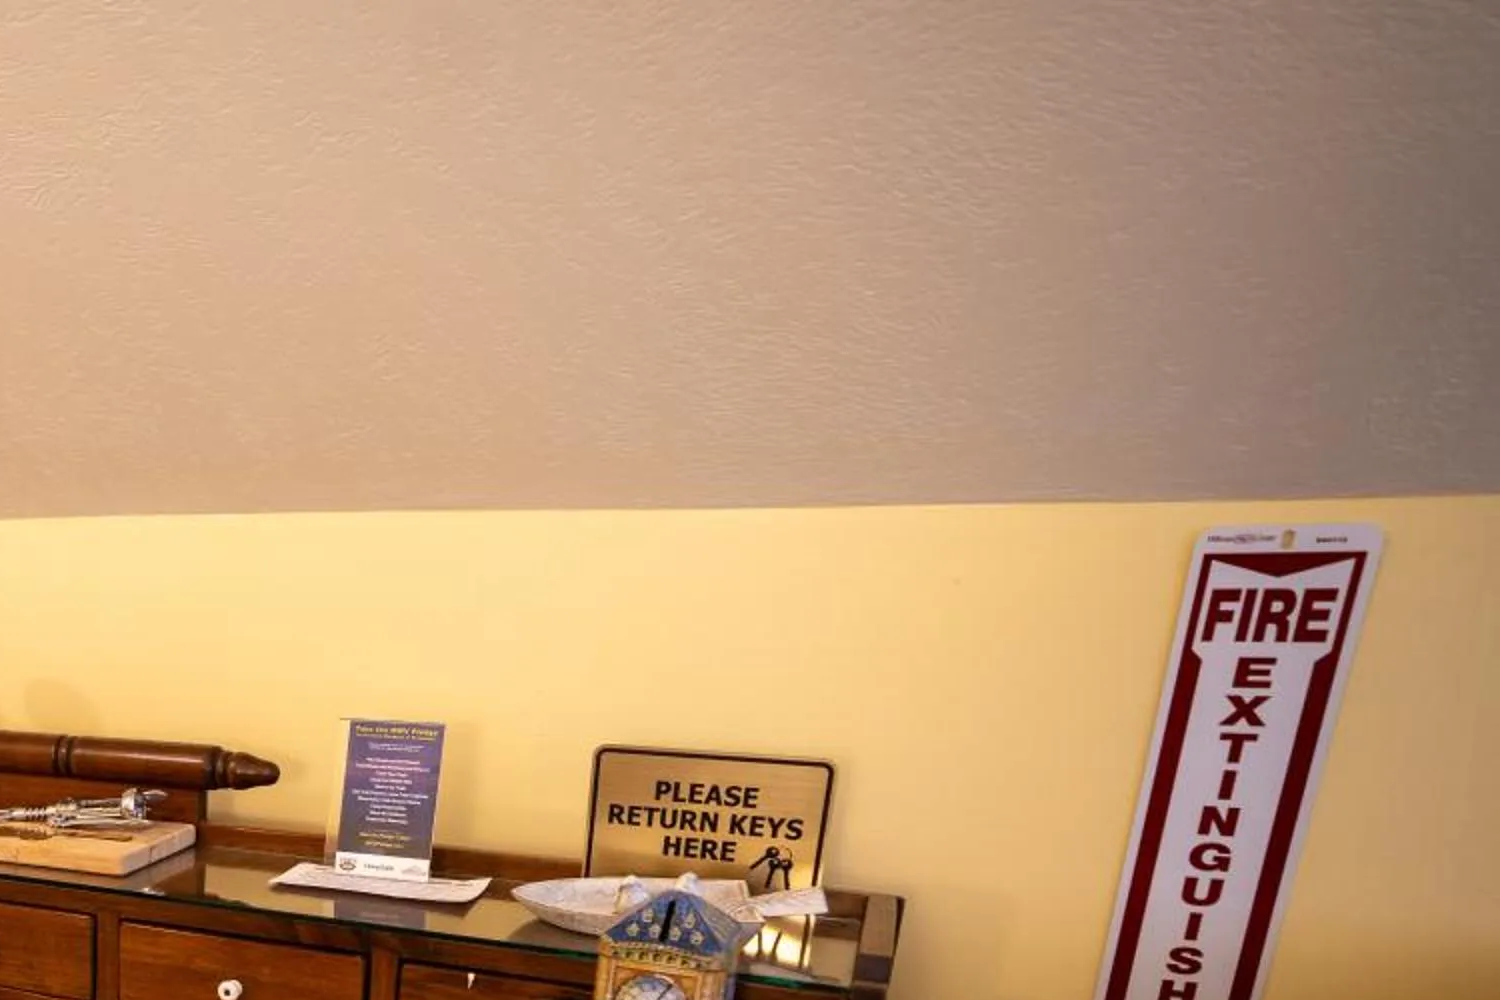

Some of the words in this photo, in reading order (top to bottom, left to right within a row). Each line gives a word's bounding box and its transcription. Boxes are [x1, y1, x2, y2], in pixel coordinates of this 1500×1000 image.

[1201, 587, 1339, 643] FIRE
[653, 780, 761, 809] PLEASE
[607, 802, 720, 834] RETURN
[728, 813, 805, 842] KEYS
[661, 835, 737, 863] HERE
